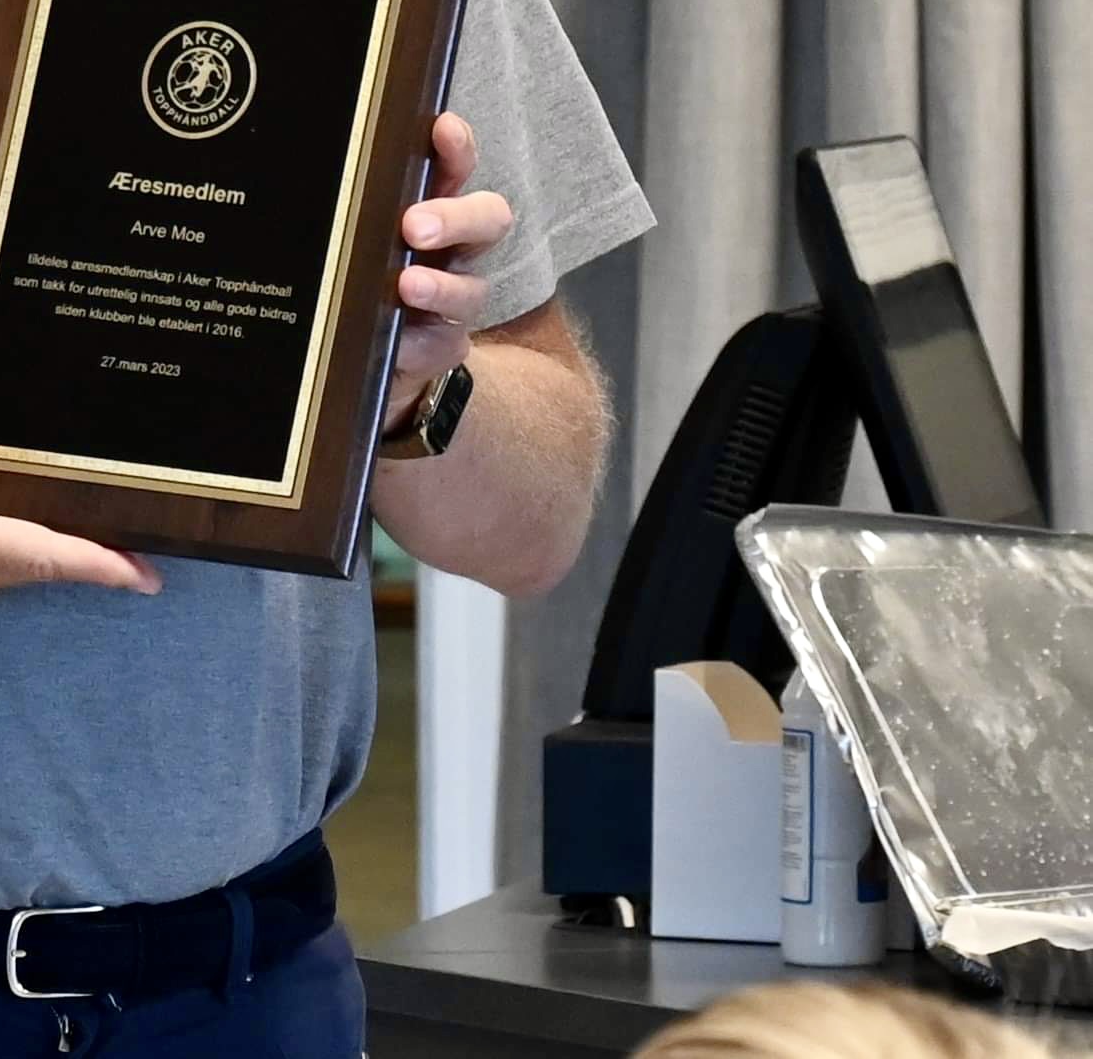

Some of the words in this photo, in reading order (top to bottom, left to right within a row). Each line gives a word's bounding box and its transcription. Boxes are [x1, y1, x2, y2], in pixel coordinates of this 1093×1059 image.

[182, 30, 235, 56] AKER
[153, 86, 239, 126] TOPPHÅNDBALL
[108, 171, 246, 205] Æresmedlem
[130, 220, 167, 238] Arve
[171, 224, 206, 243] Moe
[27, 253, 68, 269] tildeles
[71, 260, 175, 283] æresmedlemskap
[183, 273, 212, 287] Aker
[215, 276, 293, 297] Topphåndball
[13, 276, 39, 288] som
[42, 279, 66, 292] takk
[68, 281, 85, 293] for
[87, 284, 138, 303] utrettelig
[140, 291, 182, 307] innsats
[185, 298, 201, 312] og
[203, 300, 224, 313] alle
[227, 304, 256, 317] gode
[259, 306, 298, 324] bidrag
[55, 304, 86, 318] siden
[88, 308, 135, 325] klubben
[137, 314, 156, 327] ble
[158, 318, 203, 333] etablert
[150, 361, 182, 377] 2023
